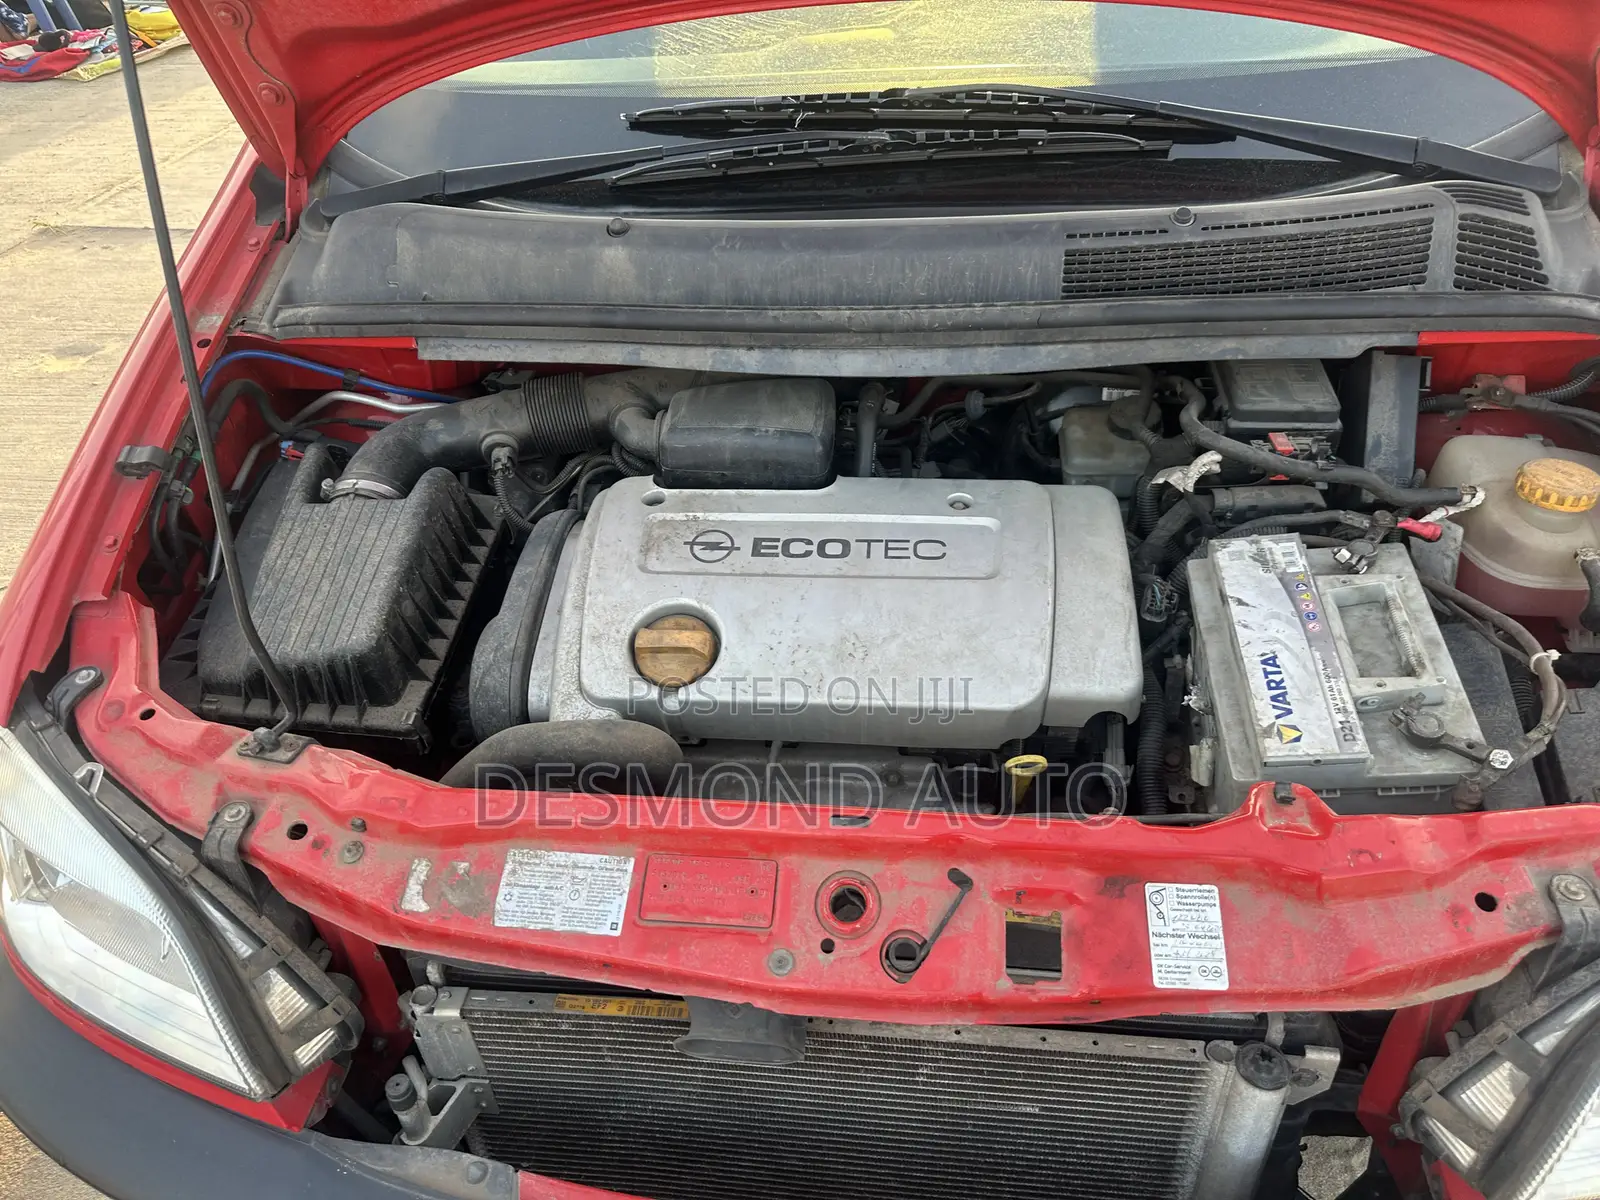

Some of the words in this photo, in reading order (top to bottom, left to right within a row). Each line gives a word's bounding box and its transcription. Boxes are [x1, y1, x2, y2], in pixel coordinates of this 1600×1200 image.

[750, 537, 947, 560] ECOTEC
[1260, 655, 1294, 720] VARTA
[1338, 719, 1357, 743] D21
